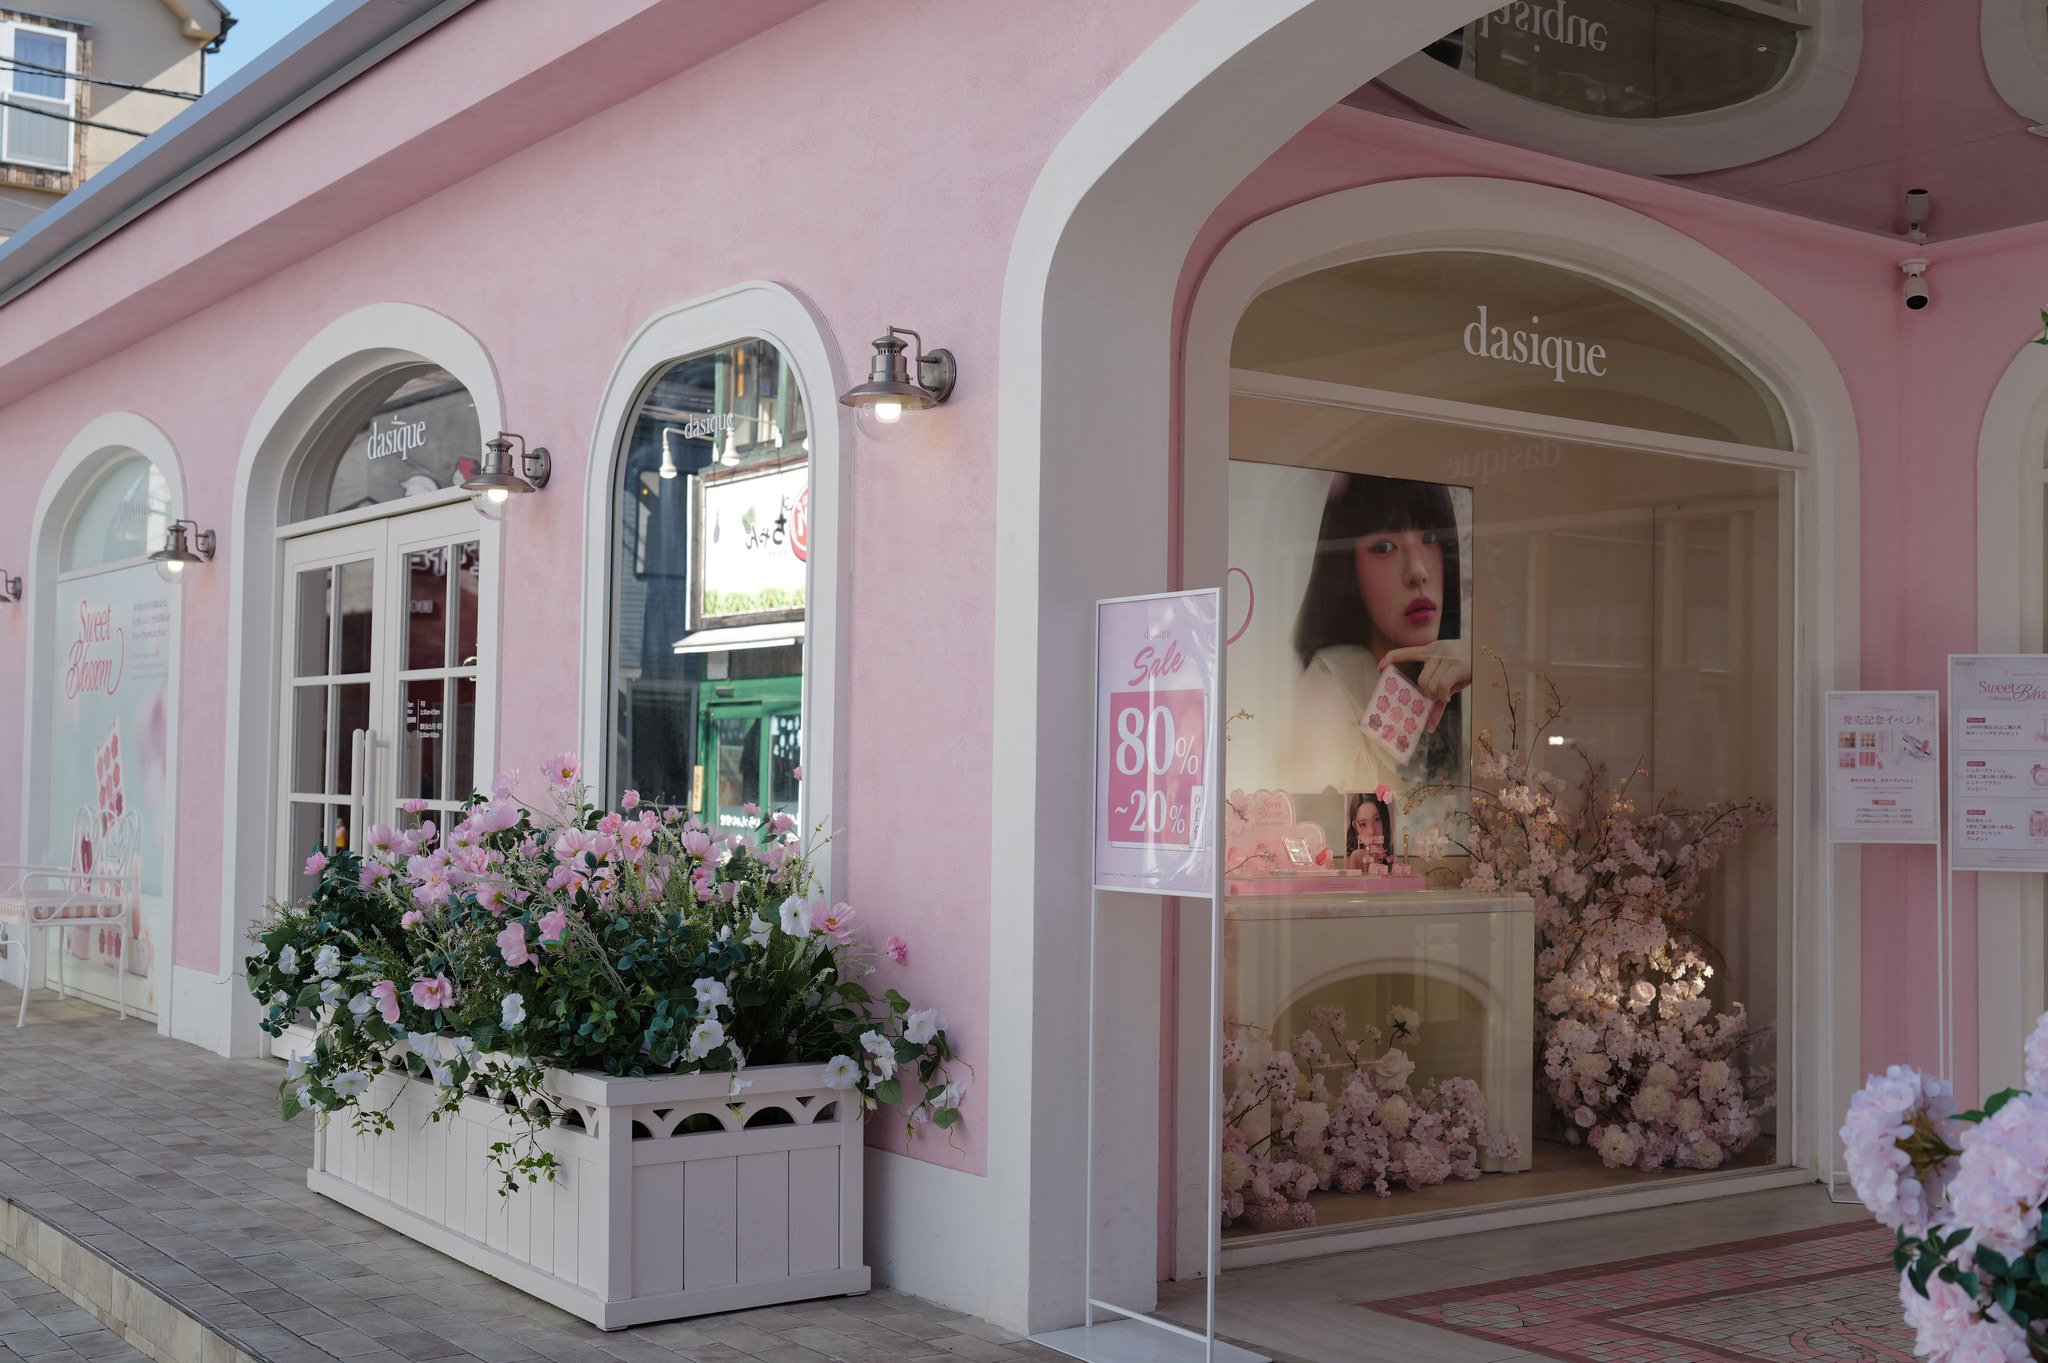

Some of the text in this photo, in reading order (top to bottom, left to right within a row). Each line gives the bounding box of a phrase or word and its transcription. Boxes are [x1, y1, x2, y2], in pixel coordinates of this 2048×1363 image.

[1463, 305, 1607, 382] dasique
[366, 416, 426, 461] dasique
[684, 408, 735, 440] dasique
[79, 600, 112, 643] Sweet
[65, 627, 125, 699] Blossom
[1128, 639, 1186, 687] Sale
[1978, 680, 2048, 702] Sweet Blos
[1115, 705, 1199, 776] 80%
[1843, 714, 1924, 726] 発売記念イベント
